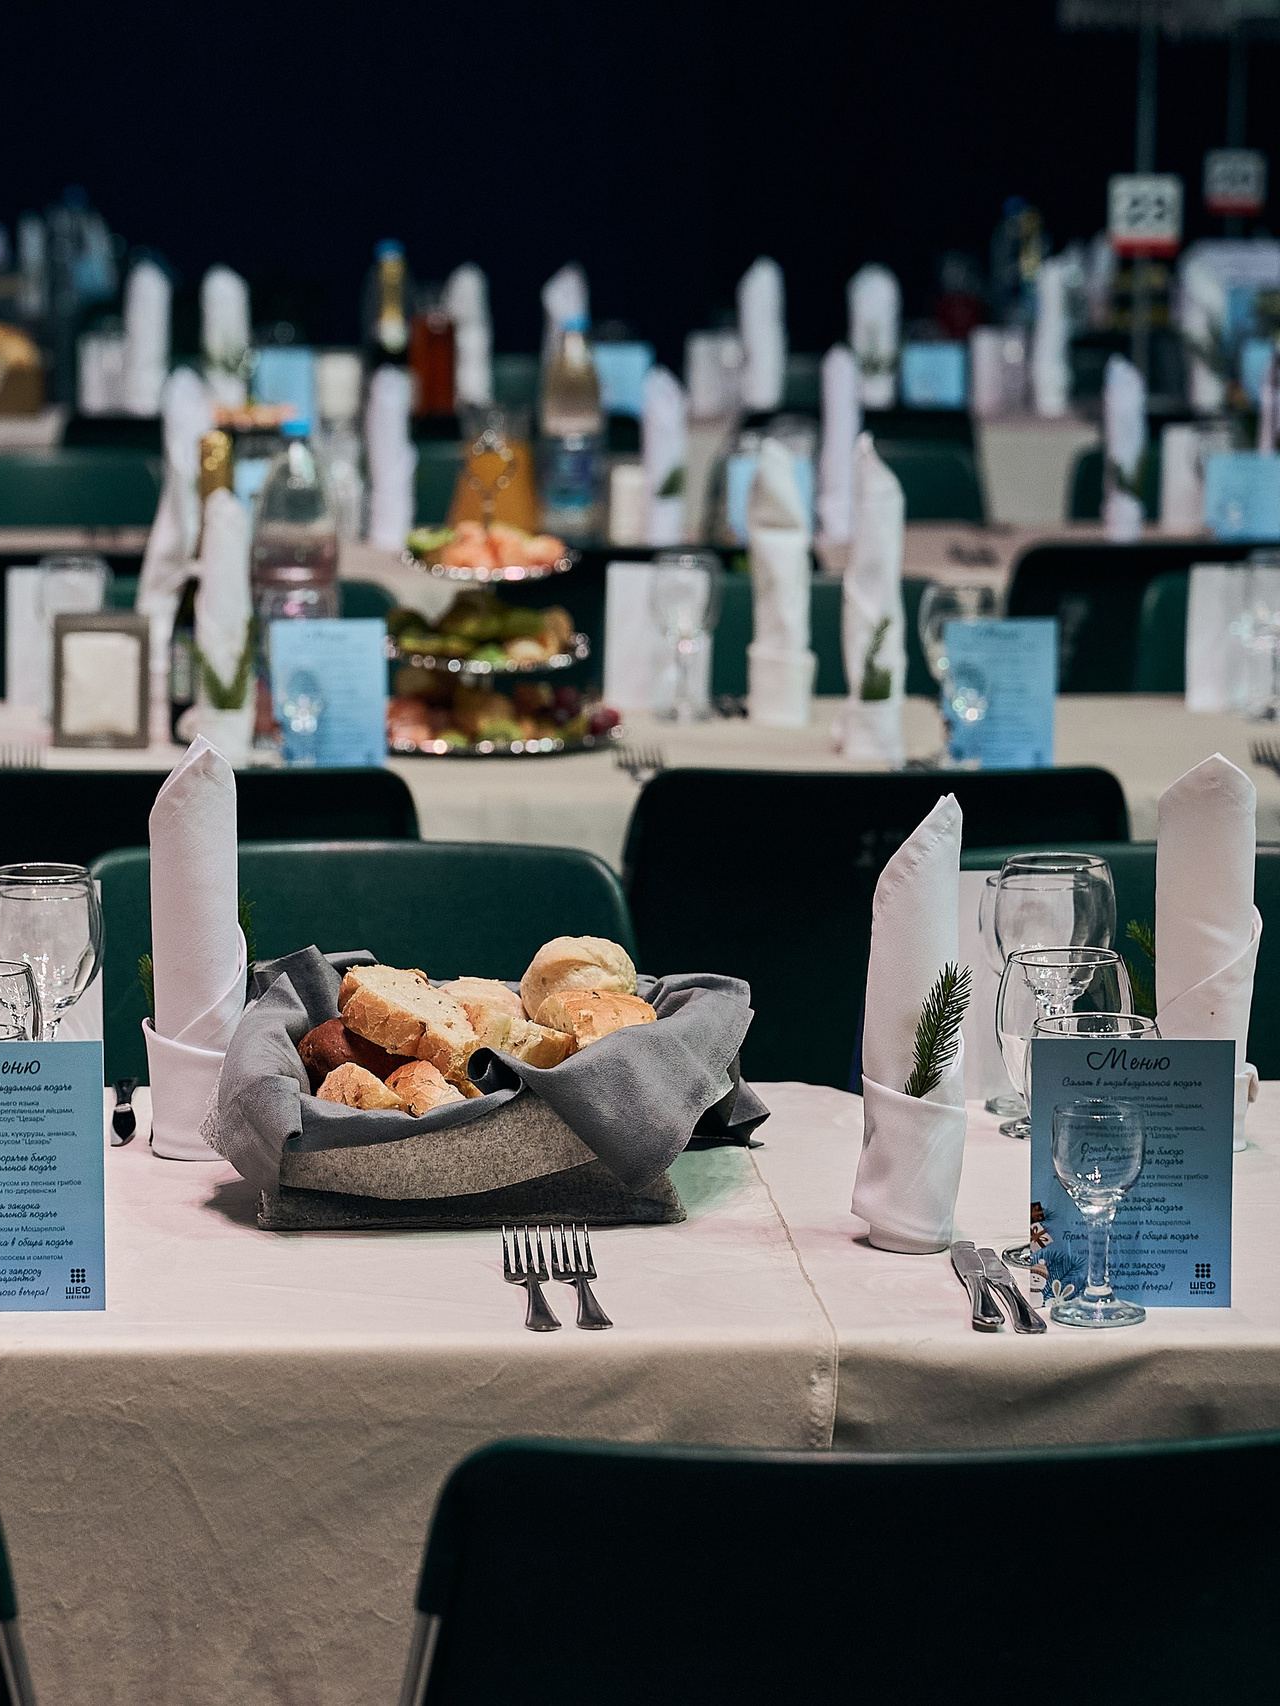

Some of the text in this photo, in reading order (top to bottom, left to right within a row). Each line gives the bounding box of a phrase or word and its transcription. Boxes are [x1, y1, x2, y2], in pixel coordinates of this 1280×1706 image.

[1087, 1047, 1171, 1070] Меню
[1062, 1077, 1093, 1087] Салат
[1103, 1077, 1170, 1089] индивидуальной
[1173, 1080, 1202, 1090] подаче
[44, 1084, 72, 1094] подаче
[0, 1116, 15, 1124] соус
[30, 1152, 56, 1163] блюдо
[1157, 1147, 1183, 1158] блюдо
[1155, 1158, 1183, 1168] подаче
[29, 1164, 57, 1174] подаче
[1133, 1196, 1166, 1206] закуска
[7, 1203, 40, 1213] закуска
[1155, 1205, 1183, 1215] подаче
[29, 1211, 57, 1221] подаче
[1142, 1230, 1168, 1242] общей
[1171, 1233, 1199, 1243] подаче
[18, 1238, 43, 1249] общей
[45, 1240, 73, 1250] подаче
[66, 1286, 91, 1294] ШЕФ
[1142, 1281, 1173, 1293] вечера!
[1190, 1281, 1216, 1290] ШЕФ
[18, 1286, 49, 1299] вечера!
